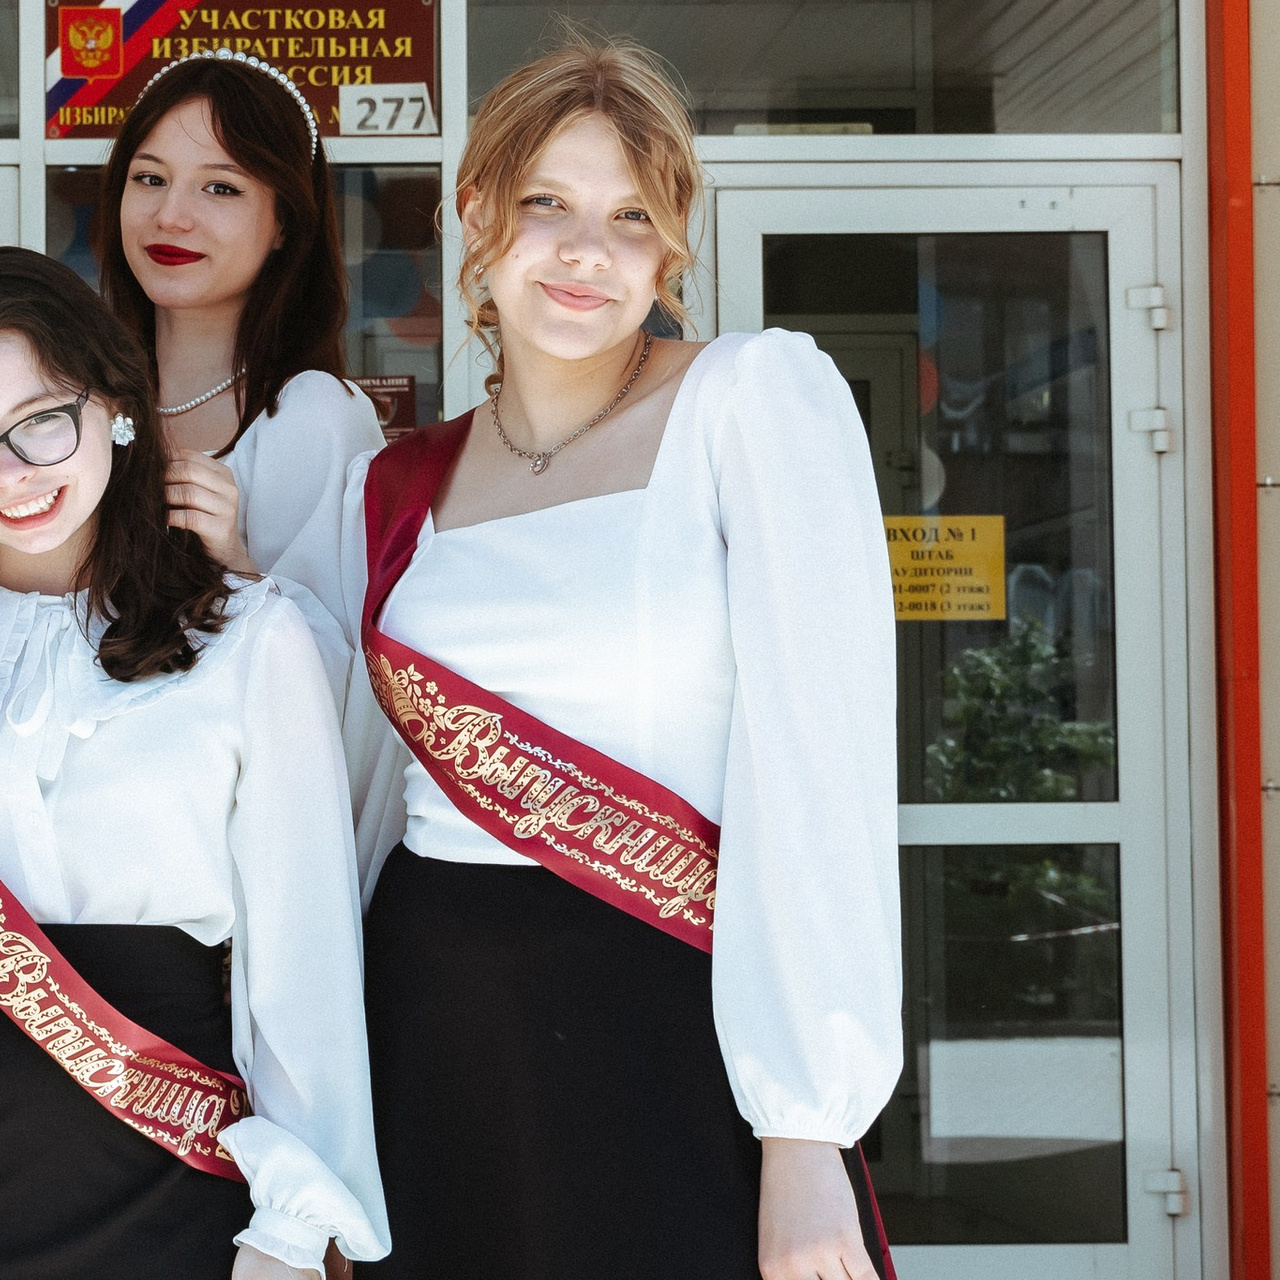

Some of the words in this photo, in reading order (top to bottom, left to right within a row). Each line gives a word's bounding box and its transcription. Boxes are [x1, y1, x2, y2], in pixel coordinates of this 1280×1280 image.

[179, 9, 385, 30] УЧАСТКОВАЯ
[286, 65, 373, 87] ССИЯ
[357, 96, 426, 131] 277
[887, 528, 940, 543] ВХОД
[970, 528, 976, 541] 1
[910, 550, 954, 561] ШТАБ
